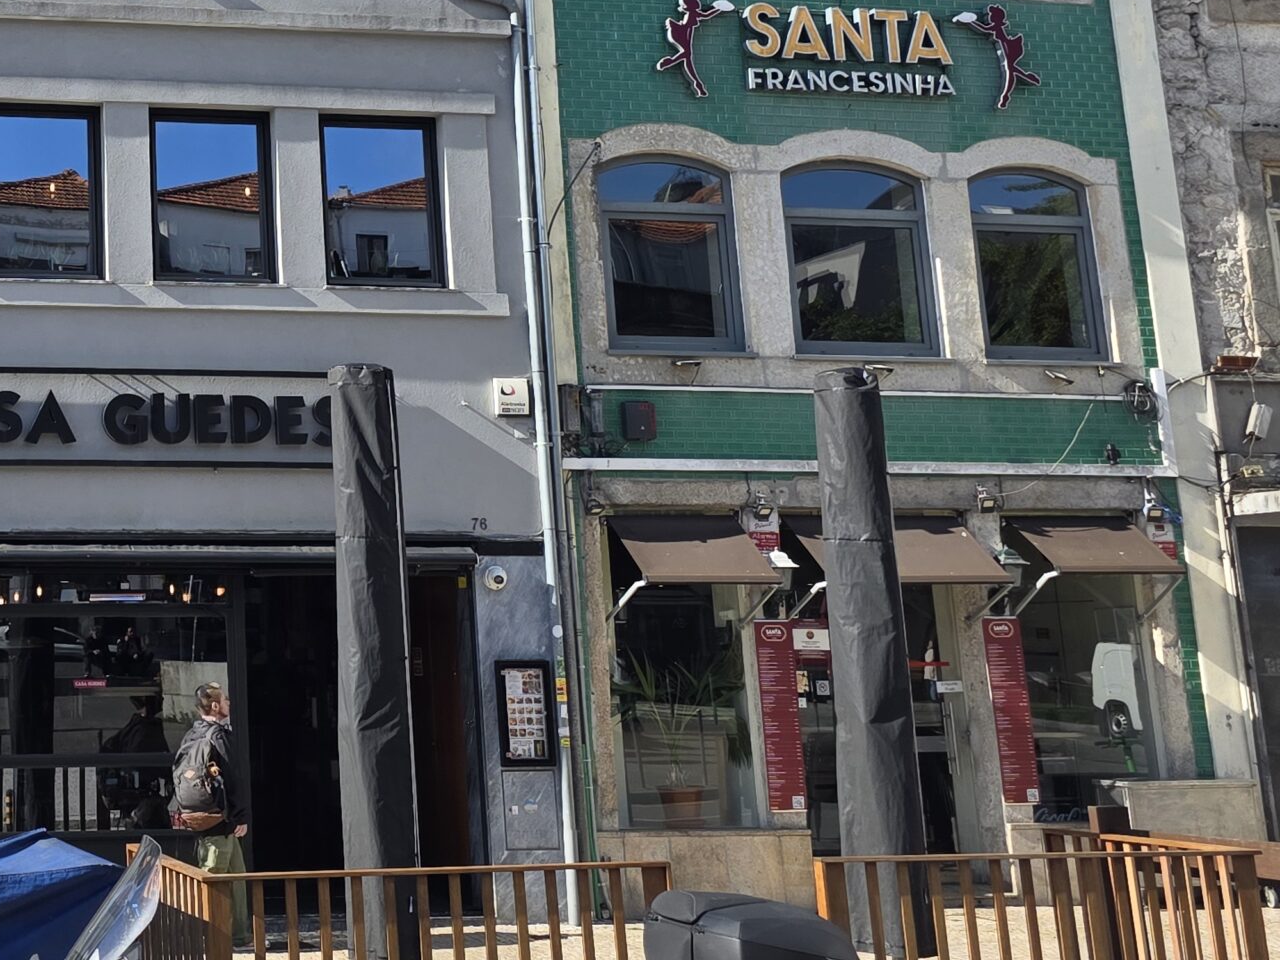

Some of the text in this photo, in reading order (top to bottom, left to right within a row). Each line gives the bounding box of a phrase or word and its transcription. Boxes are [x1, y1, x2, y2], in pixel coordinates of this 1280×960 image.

[742, 2, 954, 66] SANTA
[747, 67, 957, 96] FRANCESINHA
[471, 517, 488, 531] 76
